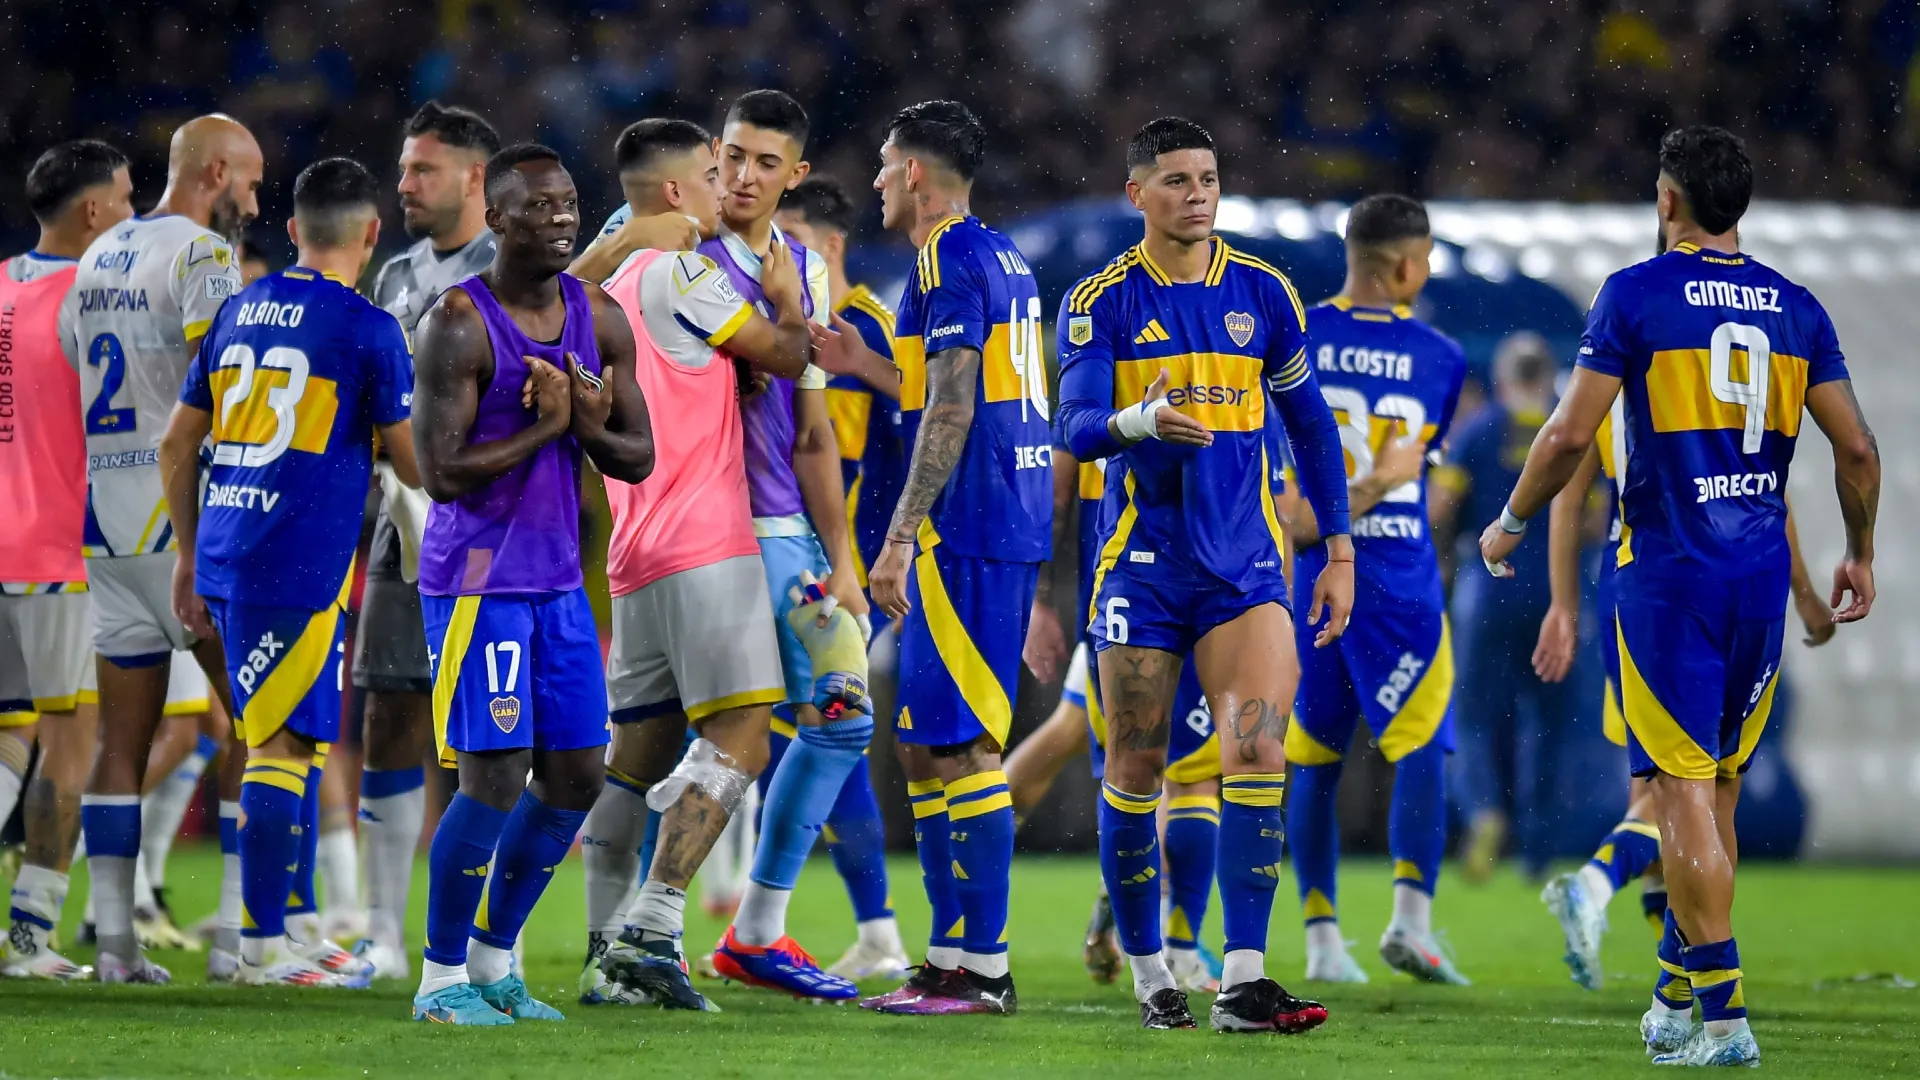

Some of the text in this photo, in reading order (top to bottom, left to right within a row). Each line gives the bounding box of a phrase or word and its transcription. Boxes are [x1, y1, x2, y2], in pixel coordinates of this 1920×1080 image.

[78, 288, 149, 317] QUINTANA
[236, 301, 304, 328] BLANCO
[1683, 280, 1783, 313] GIMENEZ
[0, 304, 15, 376] SPORTI
[1228, 323, 1251, 332] CABJ
[1316, 344, 1413, 382] A.COSTA
[85, 331, 137, 436] 2
[1709, 321, 1771, 455] 9
[212, 344, 310, 469] 23
[206, 483, 280, 513] DIRECTV
[1693, 471, 1777, 503] DIRECTV
[1351, 513, 1422, 540] RECTV
[1106, 596, 1130, 645] 6
[236, 630, 284, 695] pax
[485, 640, 521, 693] 17
[1374, 651, 1425, 714] pax
[494, 707, 517, 718] CABJ
